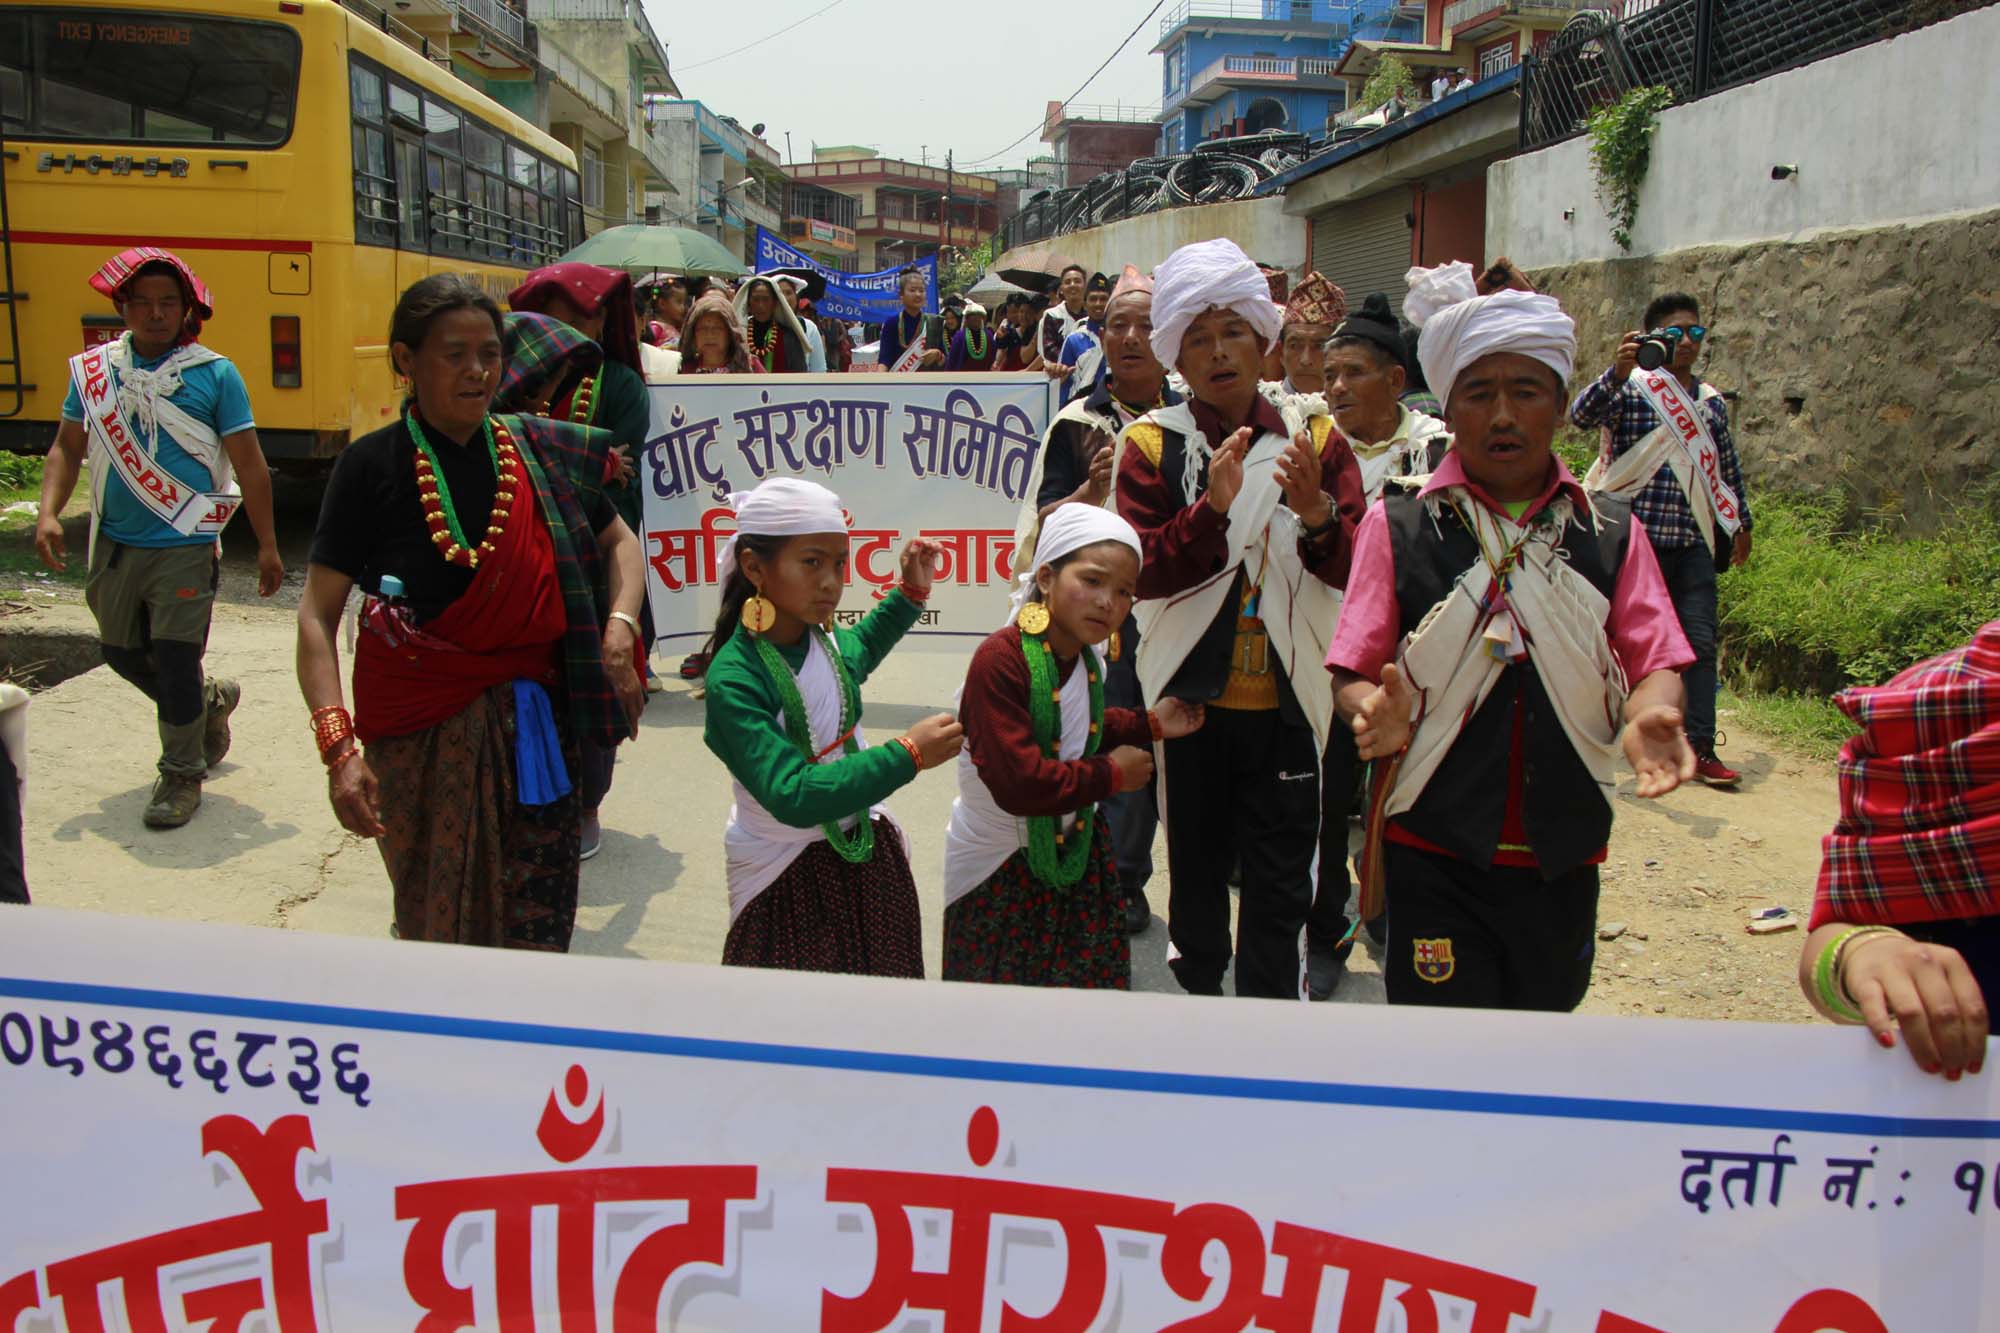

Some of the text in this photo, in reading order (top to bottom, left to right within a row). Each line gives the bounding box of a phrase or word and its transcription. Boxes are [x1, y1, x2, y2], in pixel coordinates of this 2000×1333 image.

[37, 152, 190, 178] EICHER
[644, 389, 1041, 502] घाँटु संरक्षण समिति
[1680, 1134, 1798, 1213] दर्ता
